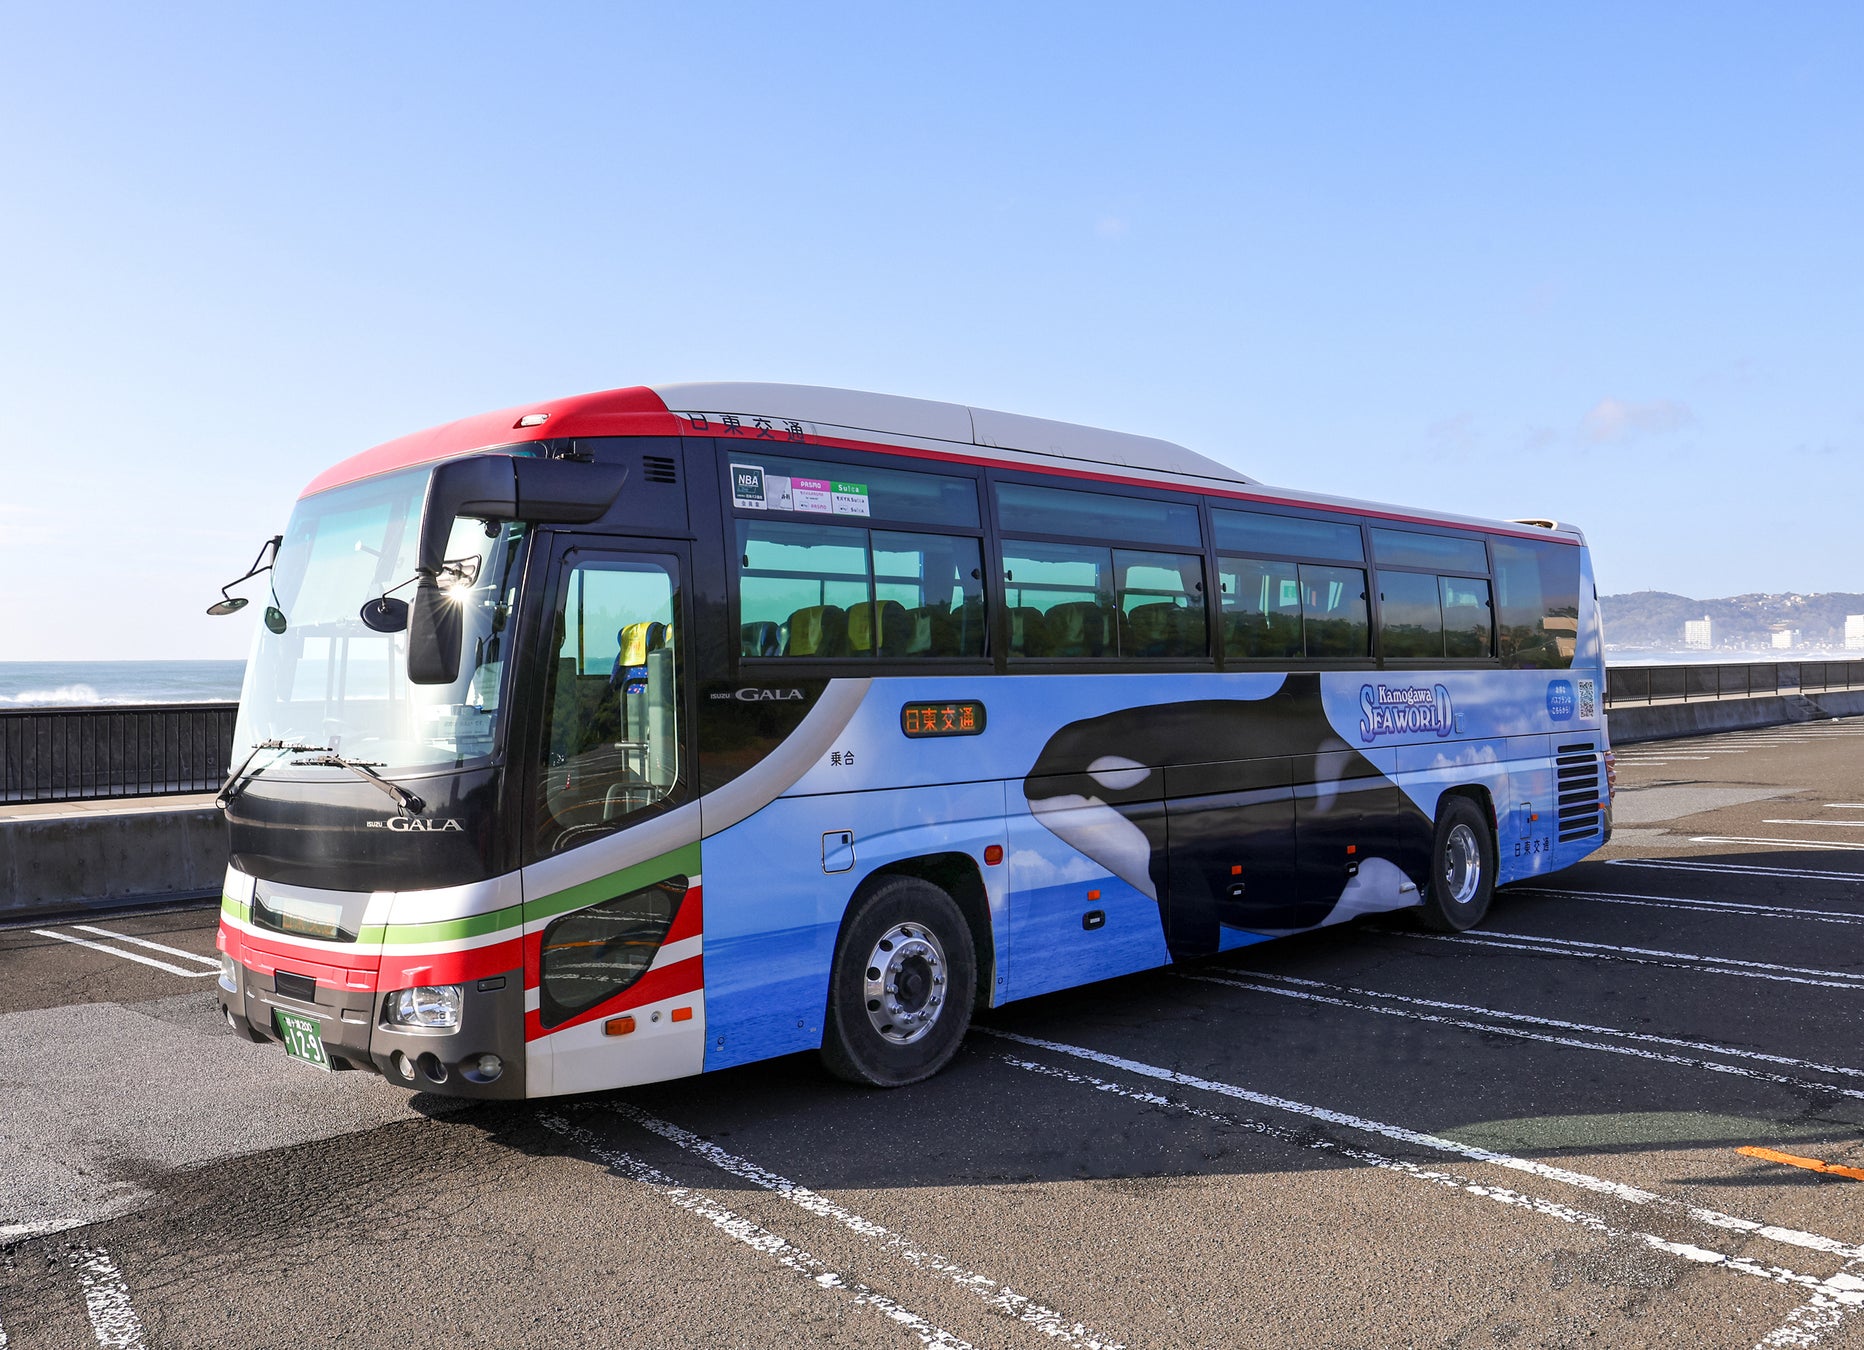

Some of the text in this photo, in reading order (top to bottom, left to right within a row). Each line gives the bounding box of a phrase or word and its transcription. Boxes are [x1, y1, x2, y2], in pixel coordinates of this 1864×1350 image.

[687, 412, 806, 443] 日東交通
[738, 474, 759, 486] NBA
[800, 480, 822, 490] PASMO
[838, 484, 861, 494] Suica
[735, 687, 804, 702] GALA
[1378, 685, 1433, 706] Kamogawa
[906, 706, 976, 733] 日東交通
[831, 750, 855, 767] 乗合
[366, 816, 465, 832] ISUZU GALA
[1515, 836, 1550, 857] 日東交通
